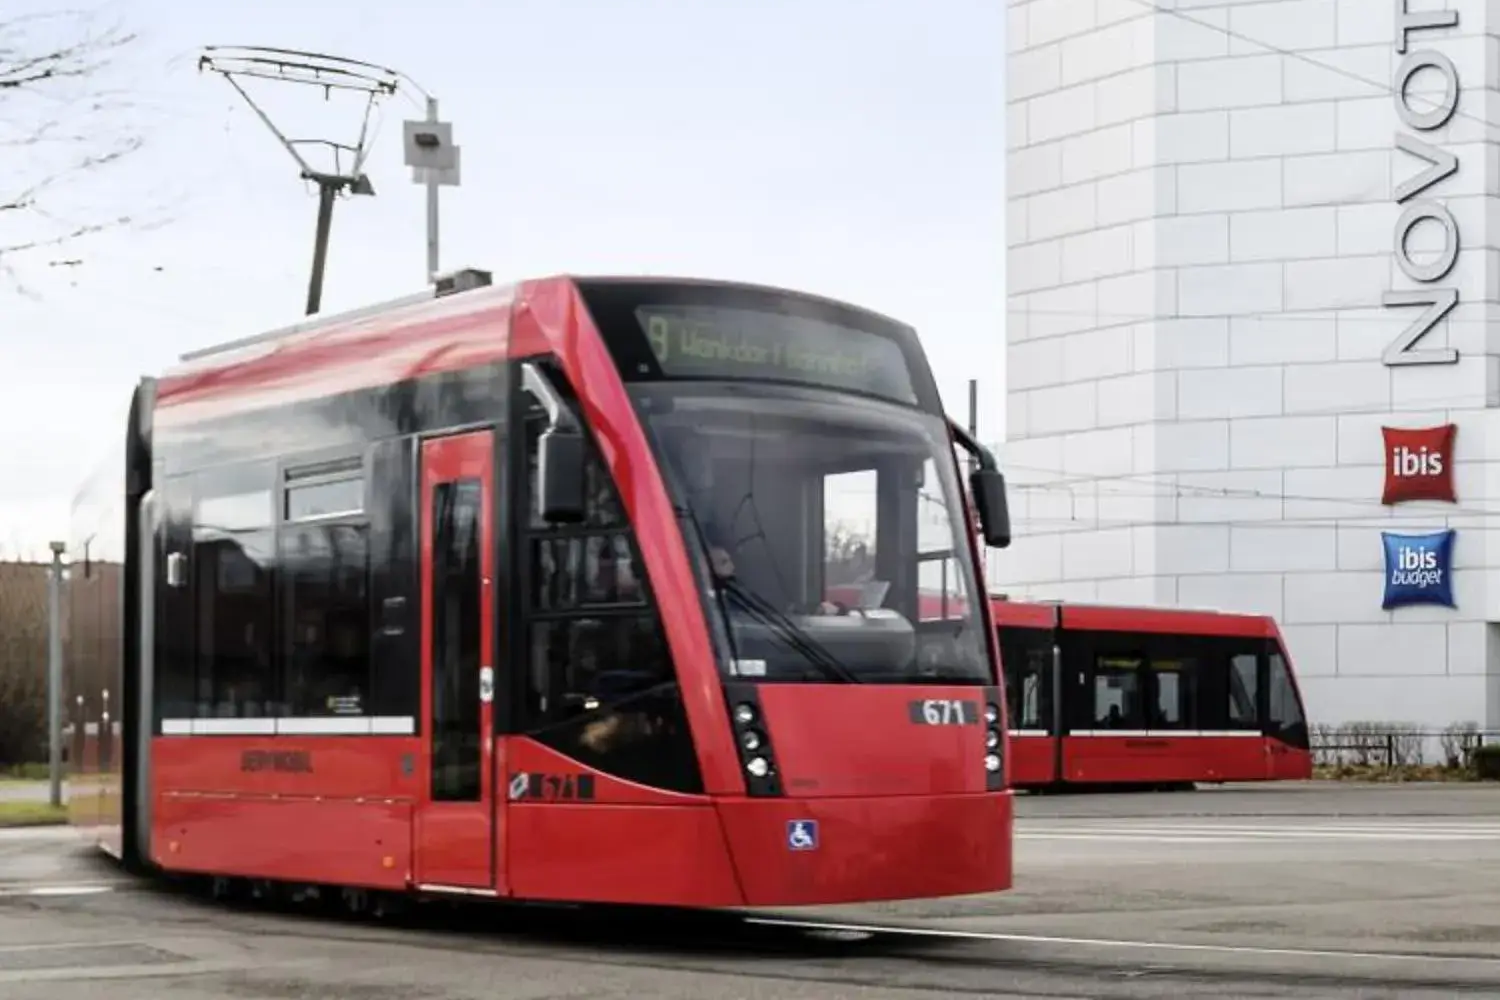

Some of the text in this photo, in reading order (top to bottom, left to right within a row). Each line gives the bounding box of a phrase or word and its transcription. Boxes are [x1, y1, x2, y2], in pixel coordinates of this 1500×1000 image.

[649, 315, 669, 363] 9
[1393, 446, 1443, 476] ibis
[1399, 546, 1437, 570] ibis
[1391, 569, 1443, 588] budget
[923, 699, 965, 726] 671
